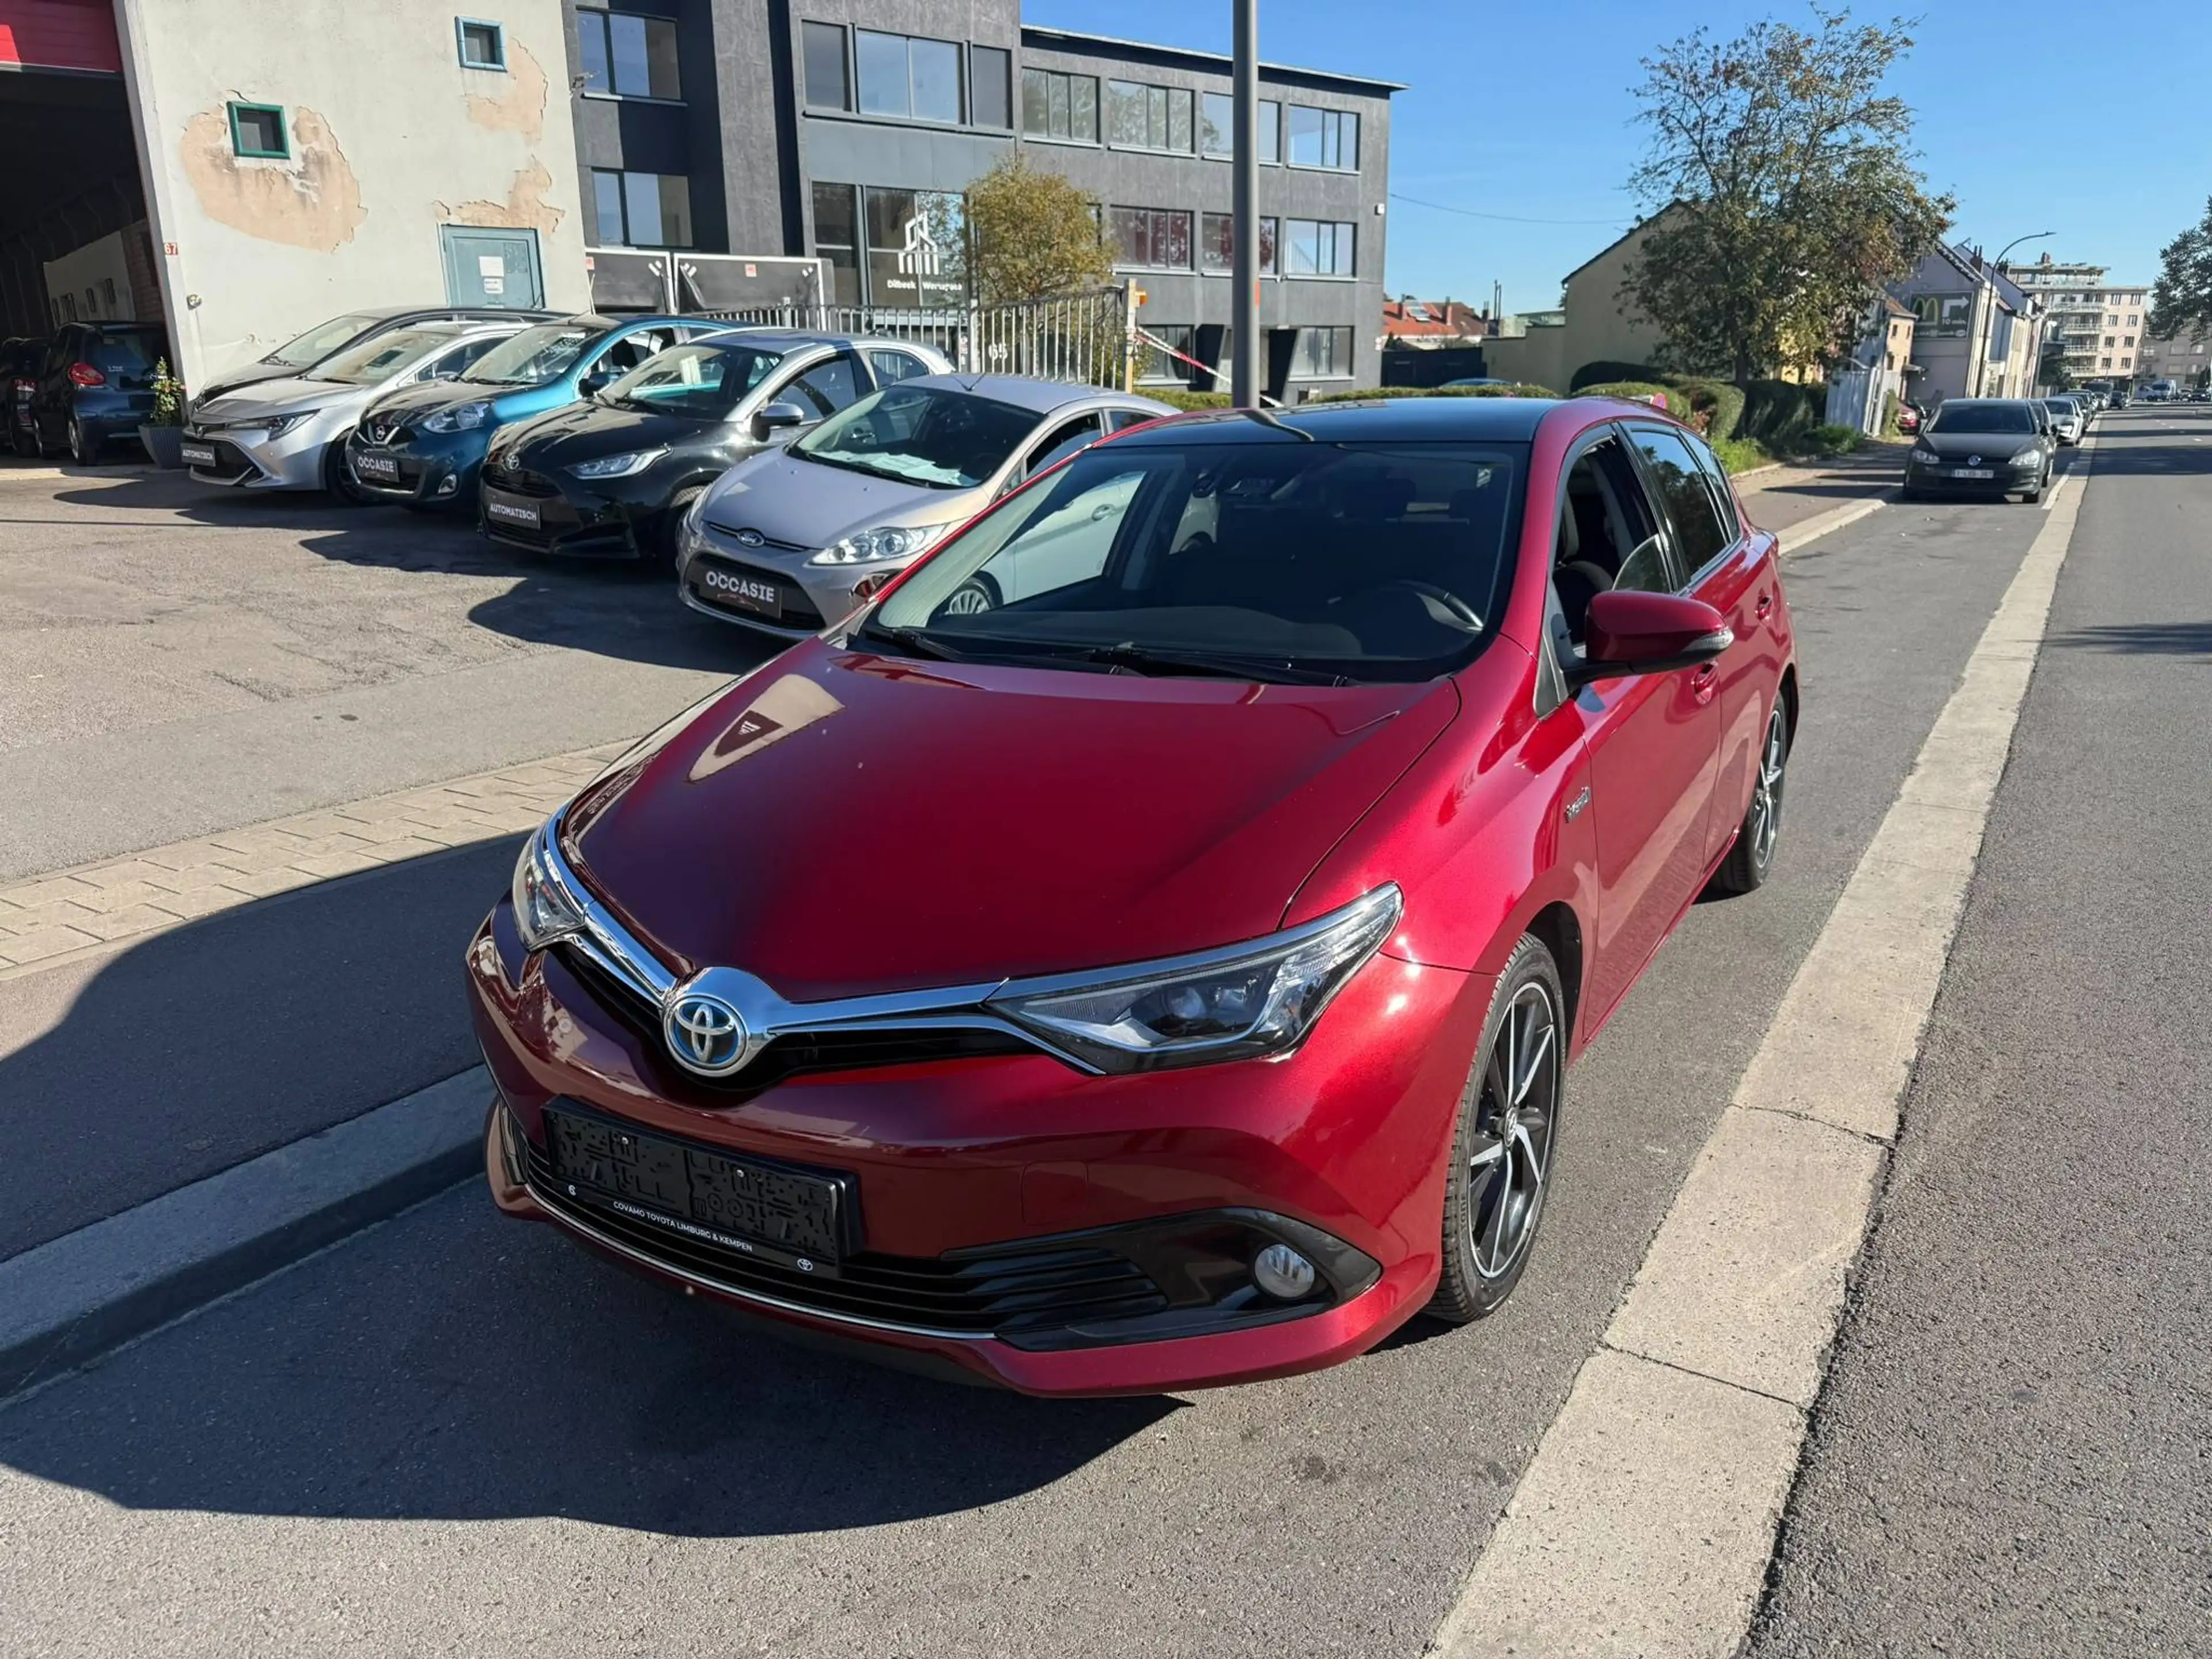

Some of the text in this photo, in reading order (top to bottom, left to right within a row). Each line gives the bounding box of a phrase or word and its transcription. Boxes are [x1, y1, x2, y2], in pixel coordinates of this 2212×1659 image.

[164, 243, 176, 254] 67
[183, 449, 213, 460] AUTOMATISCH
[358, 456, 394, 472] OCCASIE
[490, 503, 537, 521] AUTOMATISCH
[706, 571, 774, 603] OCCASIE
[613, 1201, 645, 1217] COVAMO
[646, 1211, 676, 1228] TOYOTA
[677, 1222, 711, 1238] LIMBURG
[719, 1235, 752, 1252] KEMPEN
